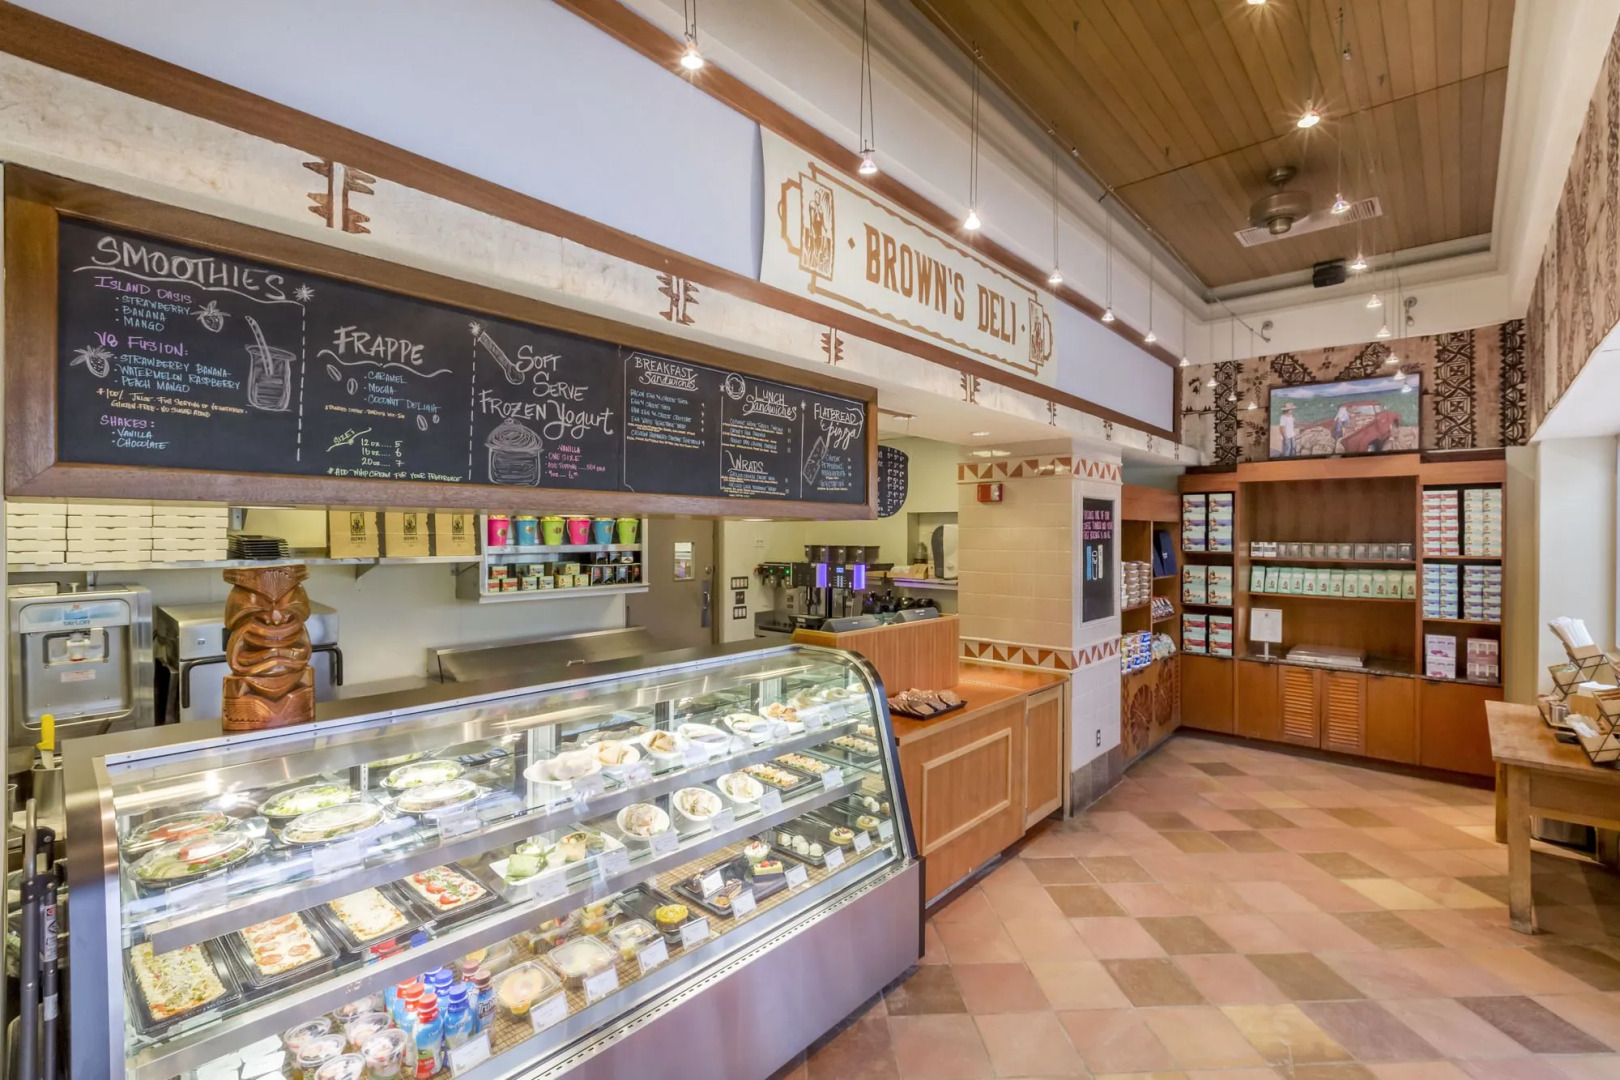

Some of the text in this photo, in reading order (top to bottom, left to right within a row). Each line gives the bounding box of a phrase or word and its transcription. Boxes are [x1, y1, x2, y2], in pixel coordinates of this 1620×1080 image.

[91, 236, 287, 300] SMOOTHIES
[94, 276, 150, 295] ISLAND
[864, 222, 1016, 345] BROWN'S DELI
[121, 295, 190, 316] STRAWBERRY
[122, 306, 167, 322] BANANA
[123, 316, 165, 332] MANGO
[94, 332, 118, 347] V8
[333, 326, 425, 365] FRAPPE
[120, 354, 232, 378] STRAWBERRY BANANA
[634, 356, 694, 380] BREAKFAST
[119, 364, 240, 390] WATERMELON RASPBERRY
[122, 377, 190, 393] PEACH MANGO
[368, 371, 407, 384] CARAMEL
[368, 383, 397, 394] MOCHA
[755, 386, 785, 406] LUNCH
[368, 395, 405, 407] COCONUT
[406, 400, 442, 413] DELIGHT
[478, 389, 547, 421] FROZEN
[543, 400, 614, 440] Yogurt
[814, 403, 858, 425] FLATBREAD
[117, 429, 154, 439] VANILLA
[117, 438, 170, 450] CHOCOLATE
[395, 449, 402, 457] 6
[558, 444, 581, 454] VANILLA
[725, 450, 764, 473] WRAPS
